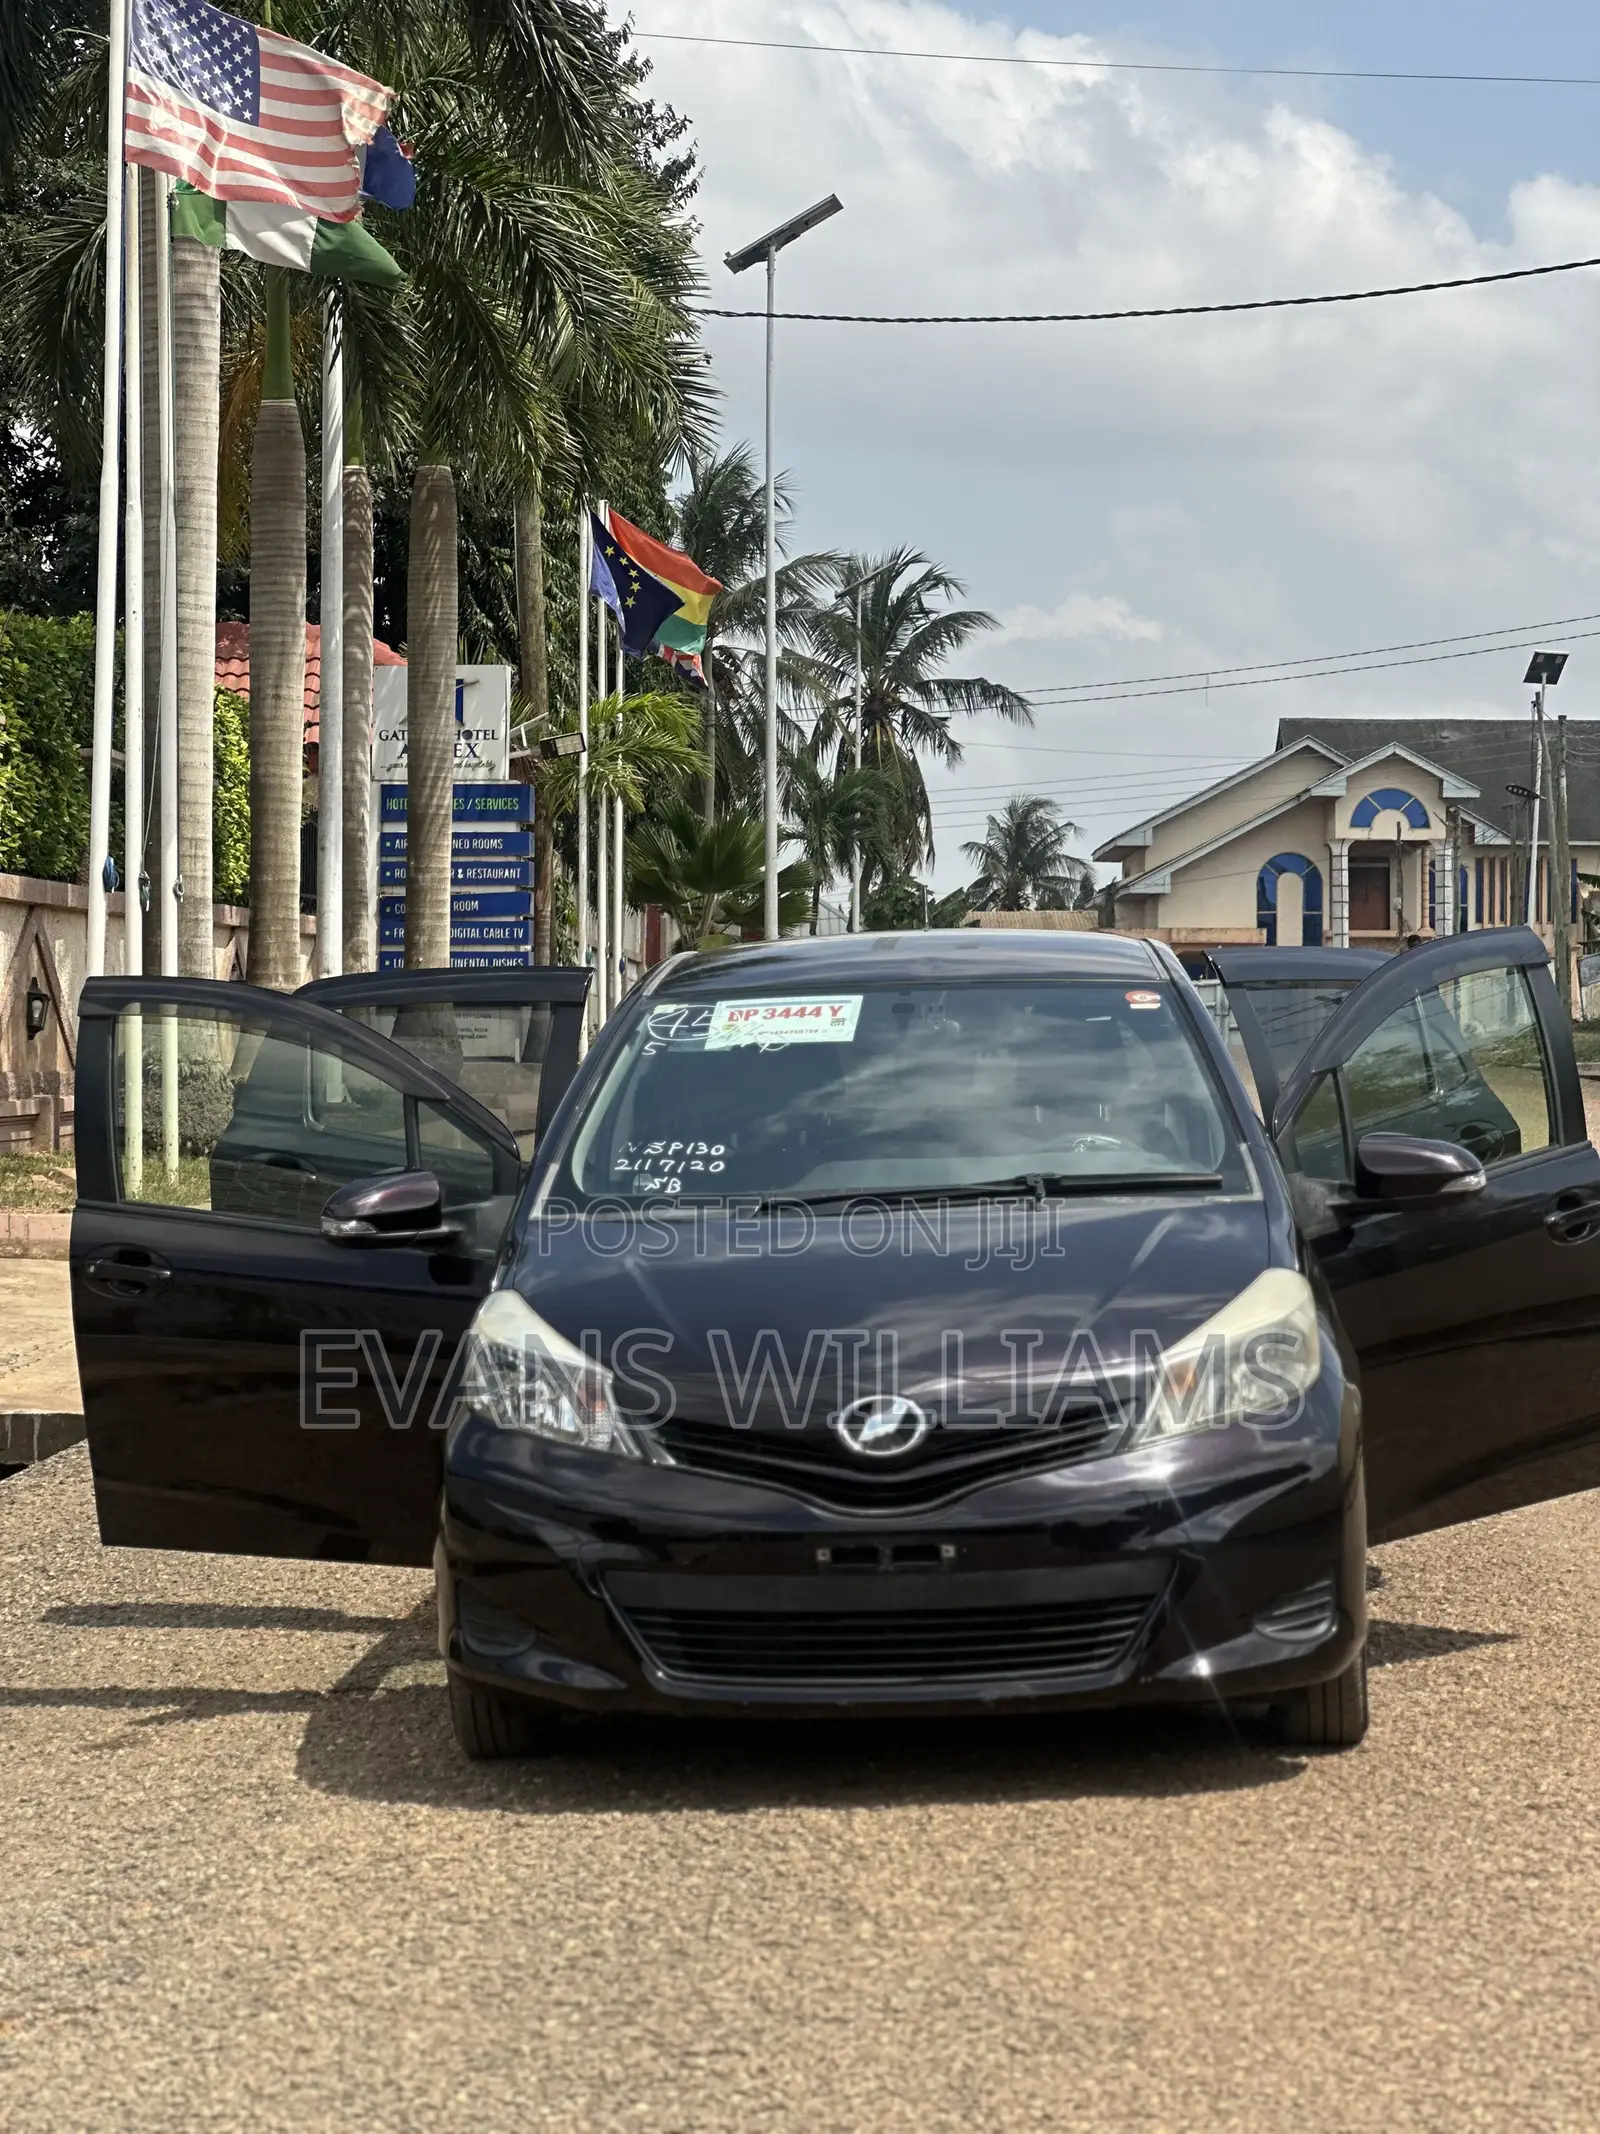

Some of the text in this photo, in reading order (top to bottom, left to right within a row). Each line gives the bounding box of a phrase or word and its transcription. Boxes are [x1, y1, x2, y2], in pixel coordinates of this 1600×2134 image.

[386, 798, 408, 811] HOTE
[475, 797, 519, 810] SERVICES
[472, 838, 503, 850] ROOMS
[457, 868, 464, 879] &
[466, 867, 521, 880] RESTAURANT
[453, 900, 479, 912] ROOM
[483, 927, 510, 939] CABLE
[513, 927, 525, 939] TV
[762, 1006, 823, 1020] 3444
[829, 1005, 844, 1018] Y
